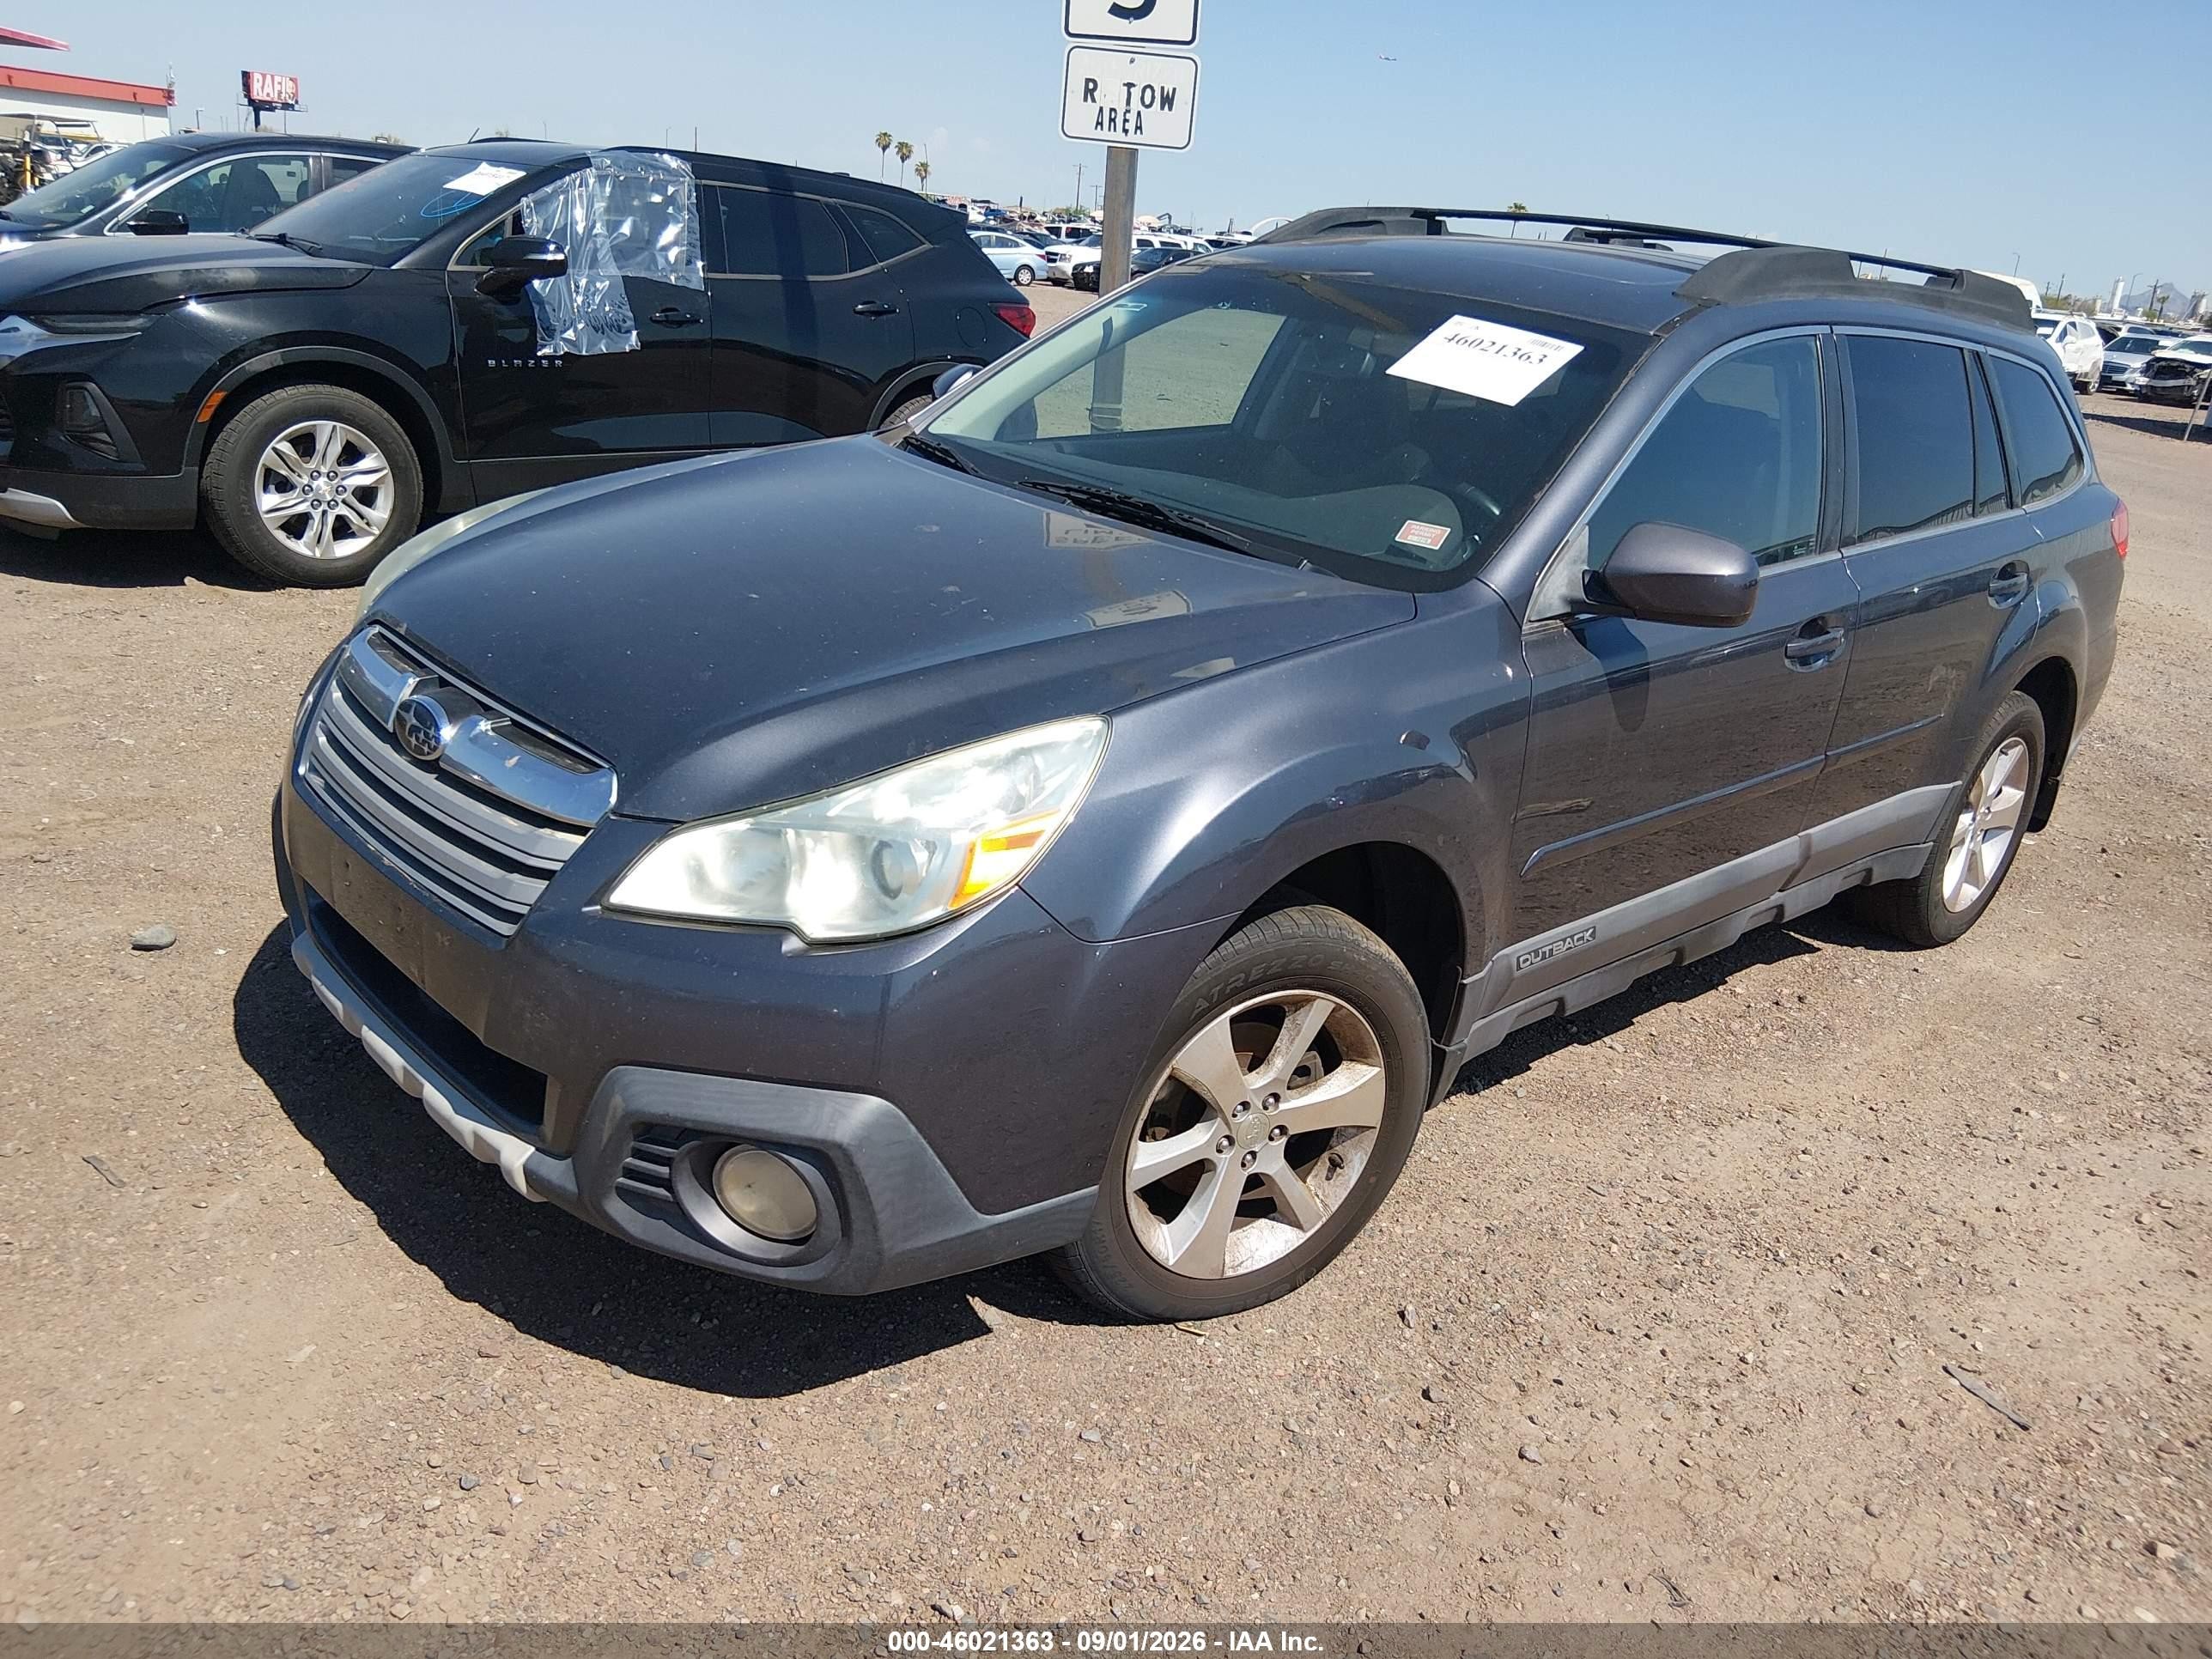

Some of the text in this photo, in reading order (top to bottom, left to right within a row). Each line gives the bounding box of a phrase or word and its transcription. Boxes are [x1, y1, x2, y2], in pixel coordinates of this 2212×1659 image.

[1122, 82, 1176, 112] TOW
[1095, 106, 1143, 136] AREA
[487, 359, 563, 368] BLAZER
[1443, 332, 1547, 365] 46021363
[1519, 927, 1595, 969] OUTBACK
[1188, 954, 1325, 1022] ATREZZO
